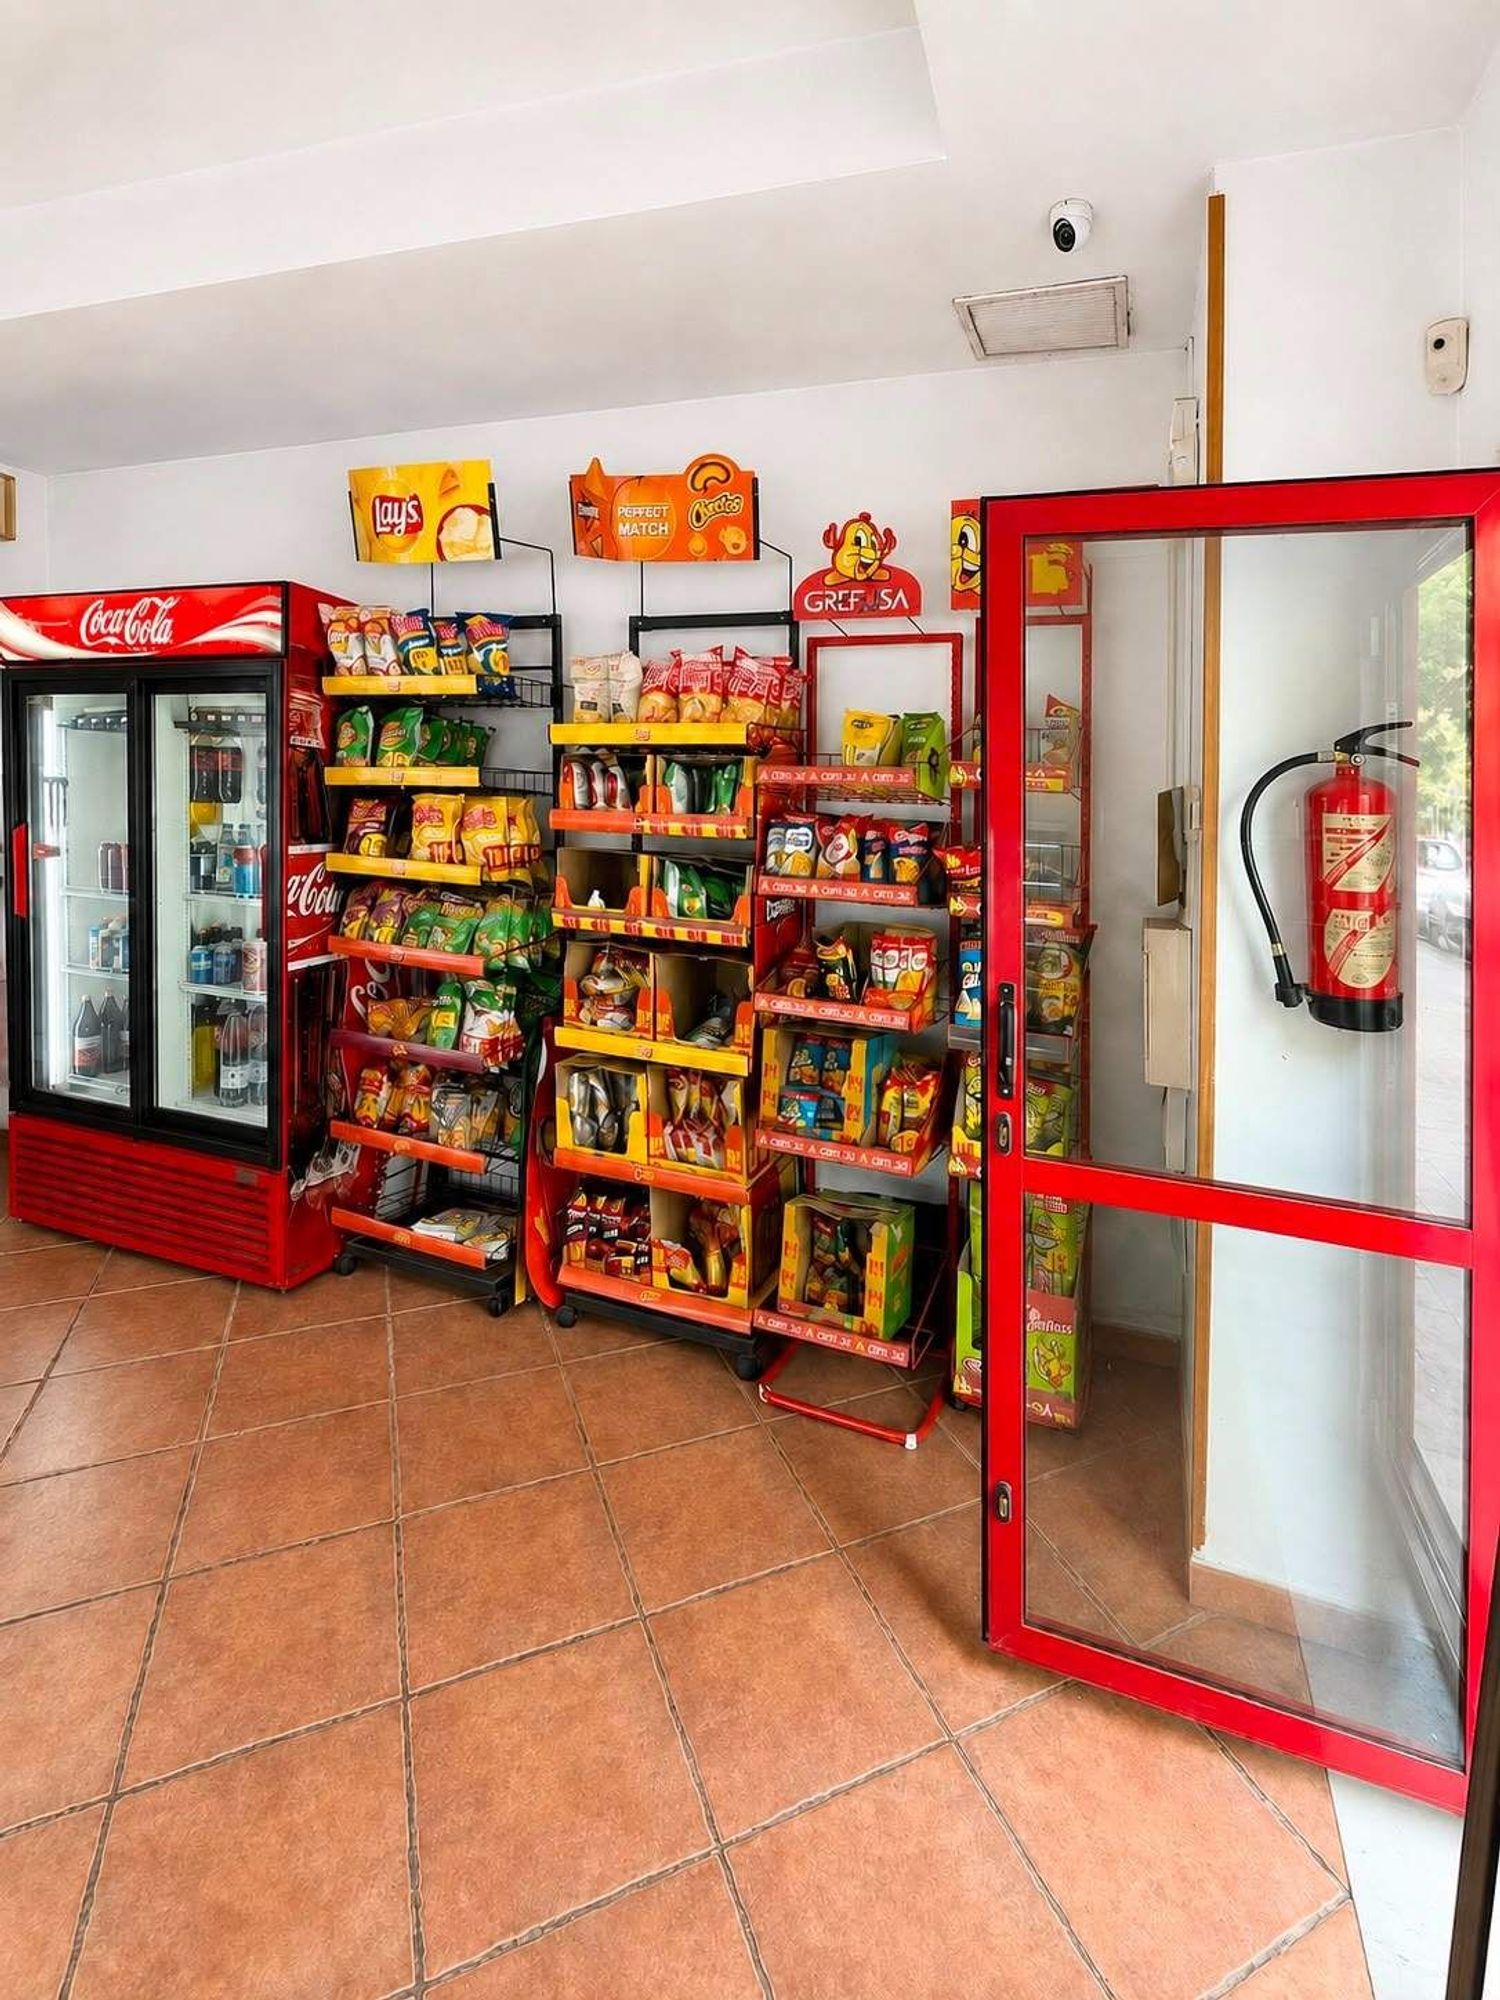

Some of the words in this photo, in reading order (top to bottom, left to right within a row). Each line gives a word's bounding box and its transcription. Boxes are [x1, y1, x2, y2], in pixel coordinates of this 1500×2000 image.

[374, 497, 421, 537] Lay's
[618, 506, 669, 518] PERFECT
[618, 523, 669, 536] MATCH
[80, 596, 180, 647] Coca-Cola
